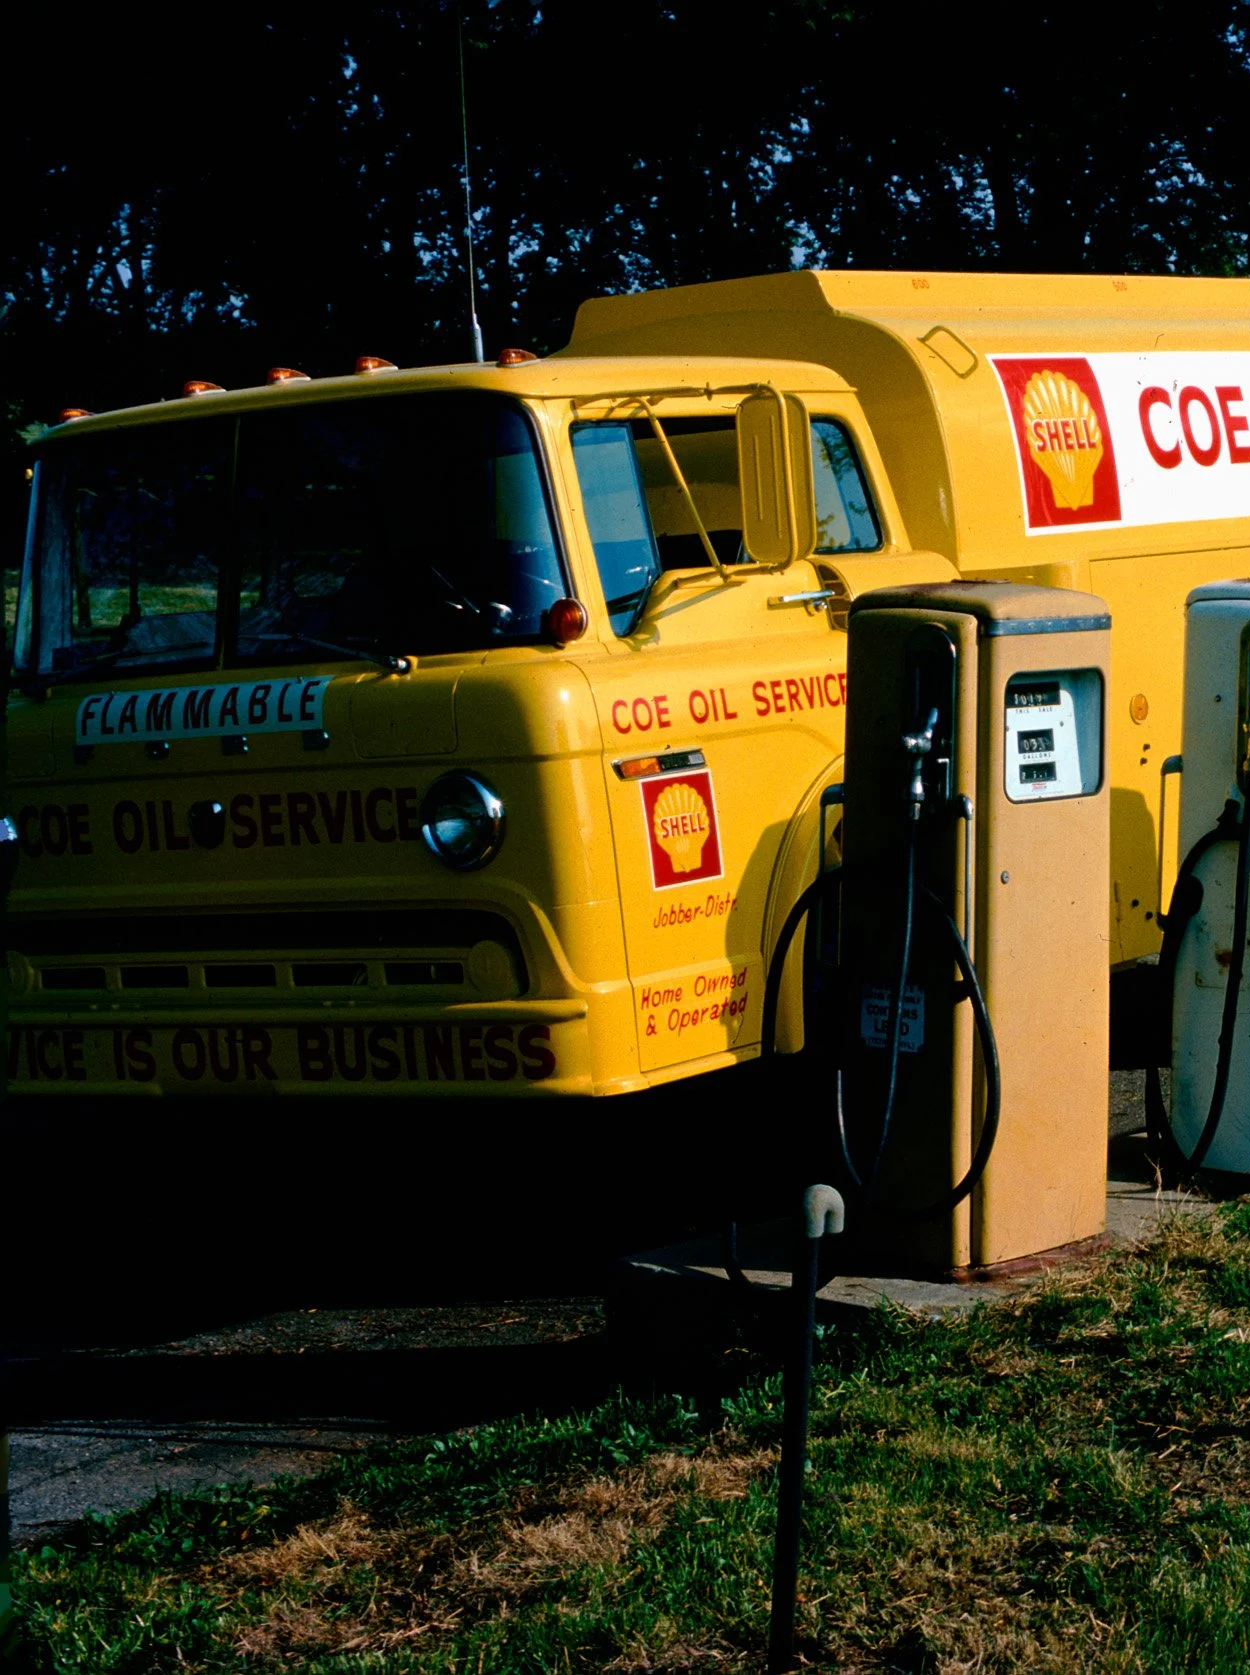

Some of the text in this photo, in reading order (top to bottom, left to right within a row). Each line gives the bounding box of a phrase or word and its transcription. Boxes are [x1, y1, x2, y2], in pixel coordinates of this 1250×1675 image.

[1033, 418, 1096, 453] SHELL
[81, 680, 322, 736] FLAMMABLE
[612, 695, 672, 735] COE
[688, 688, 738, 724] OIL
[20, 787, 421, 858] COE OIL SERVICE
[660, 813, 705, 840] SHELL
[641, 967, 748, 1011] Home Owned
[645, 992, 749, 1037] & Operated
[114, 1030, 157, 1082] IS
[173, 1027, 276, 1083] OUR
[298, 1023, 557, 1082] BUSINESS
